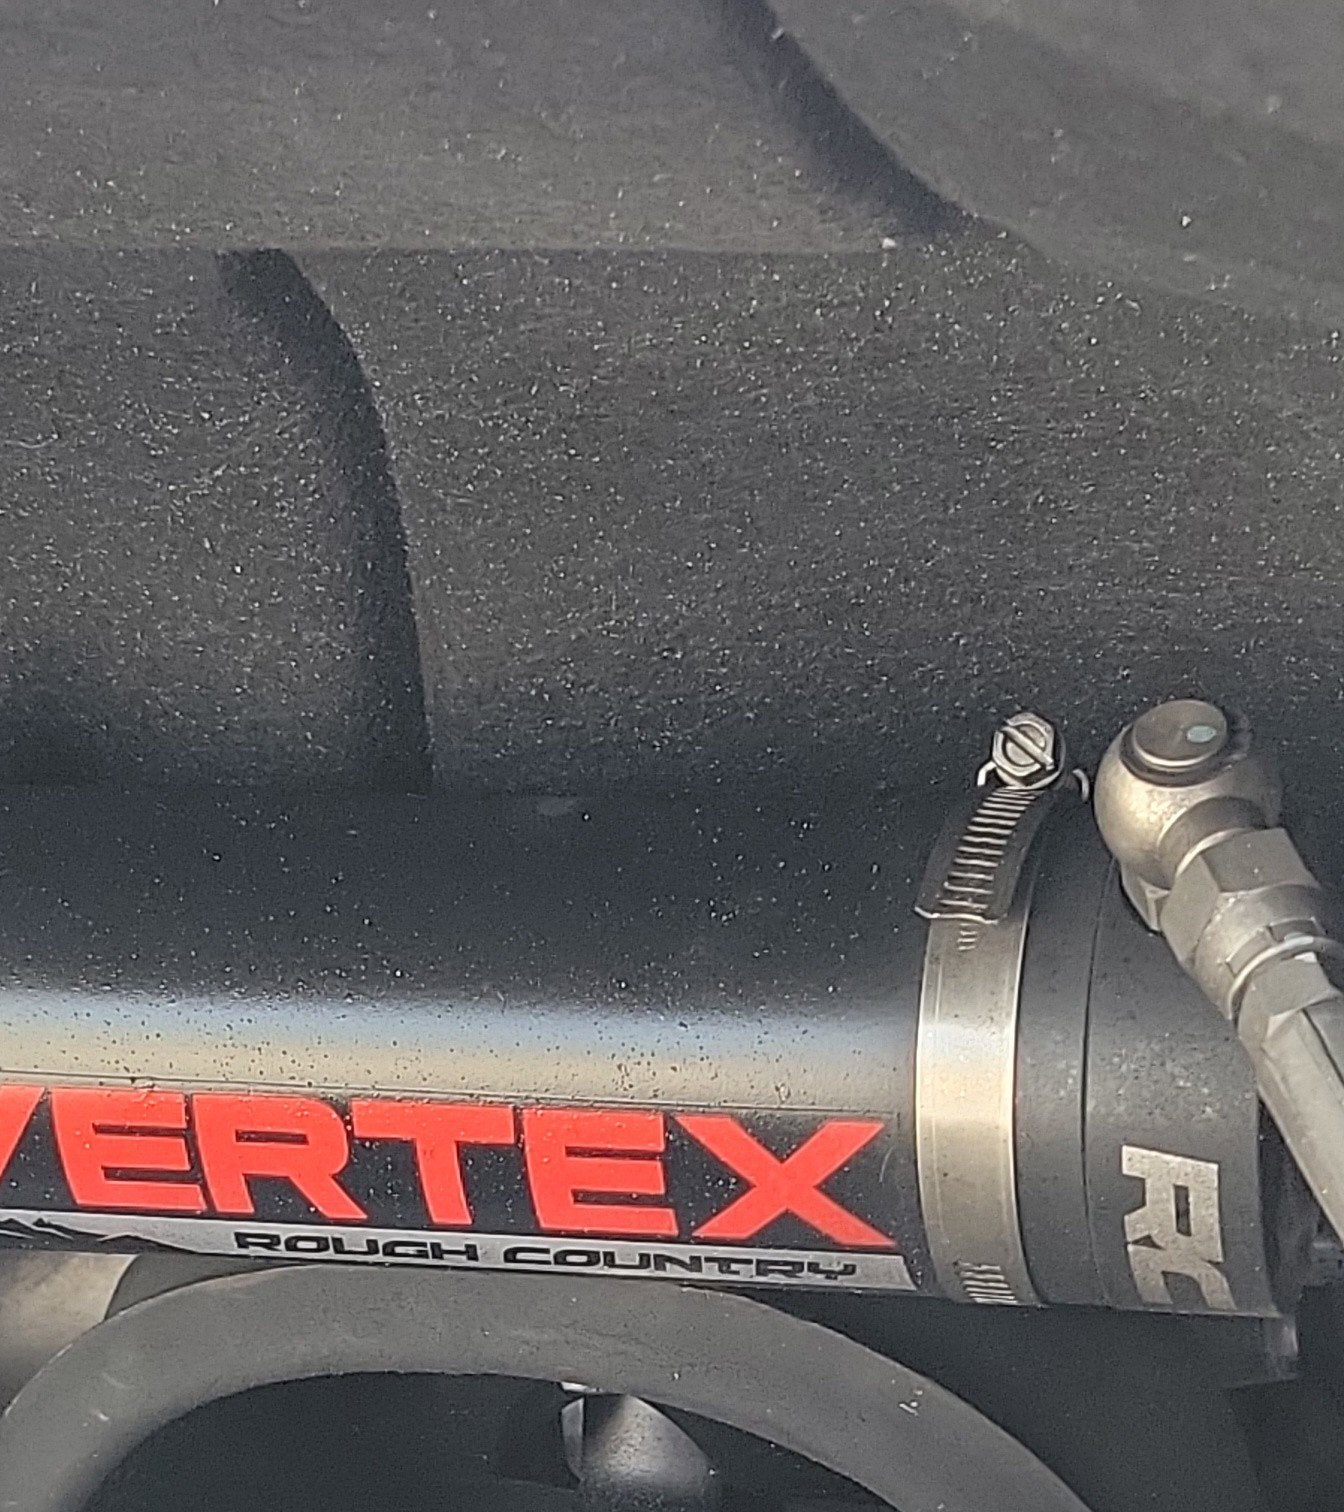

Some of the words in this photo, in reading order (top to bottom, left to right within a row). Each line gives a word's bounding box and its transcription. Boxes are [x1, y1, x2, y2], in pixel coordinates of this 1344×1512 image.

[233, 1231, 479, 1262] ROUGH
[503, 1245, 857, 1281] COUNTRY
[1122, 1145, 1237, 1310] RC
